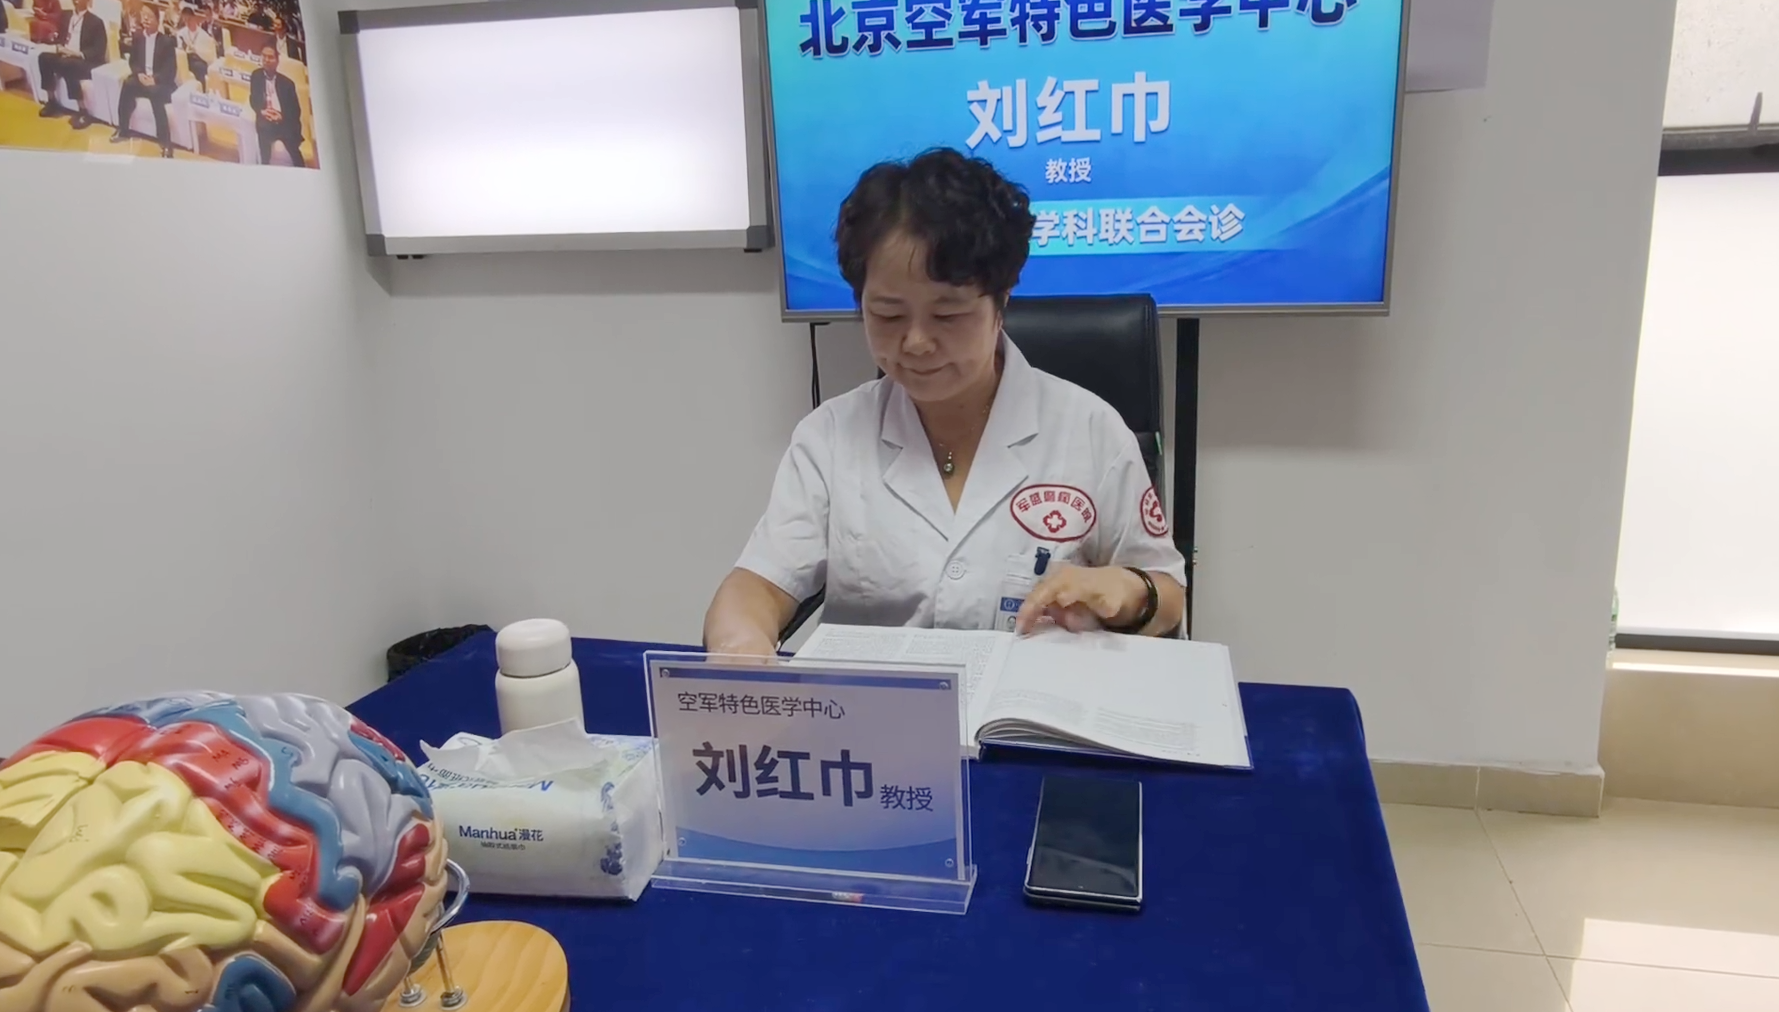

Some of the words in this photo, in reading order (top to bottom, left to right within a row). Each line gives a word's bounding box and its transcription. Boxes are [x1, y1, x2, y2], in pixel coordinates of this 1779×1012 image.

[966, 72, 1171, 149] 刘红巾
[1045, 159, 1092, 184] 教授
[677, 691, 845, 719] 空军特色医学中心
[692, 742, 874, 807] 刘红巾
[880, 784, 934, 811] 教授
[459, 825, 516, 841] Manhua
